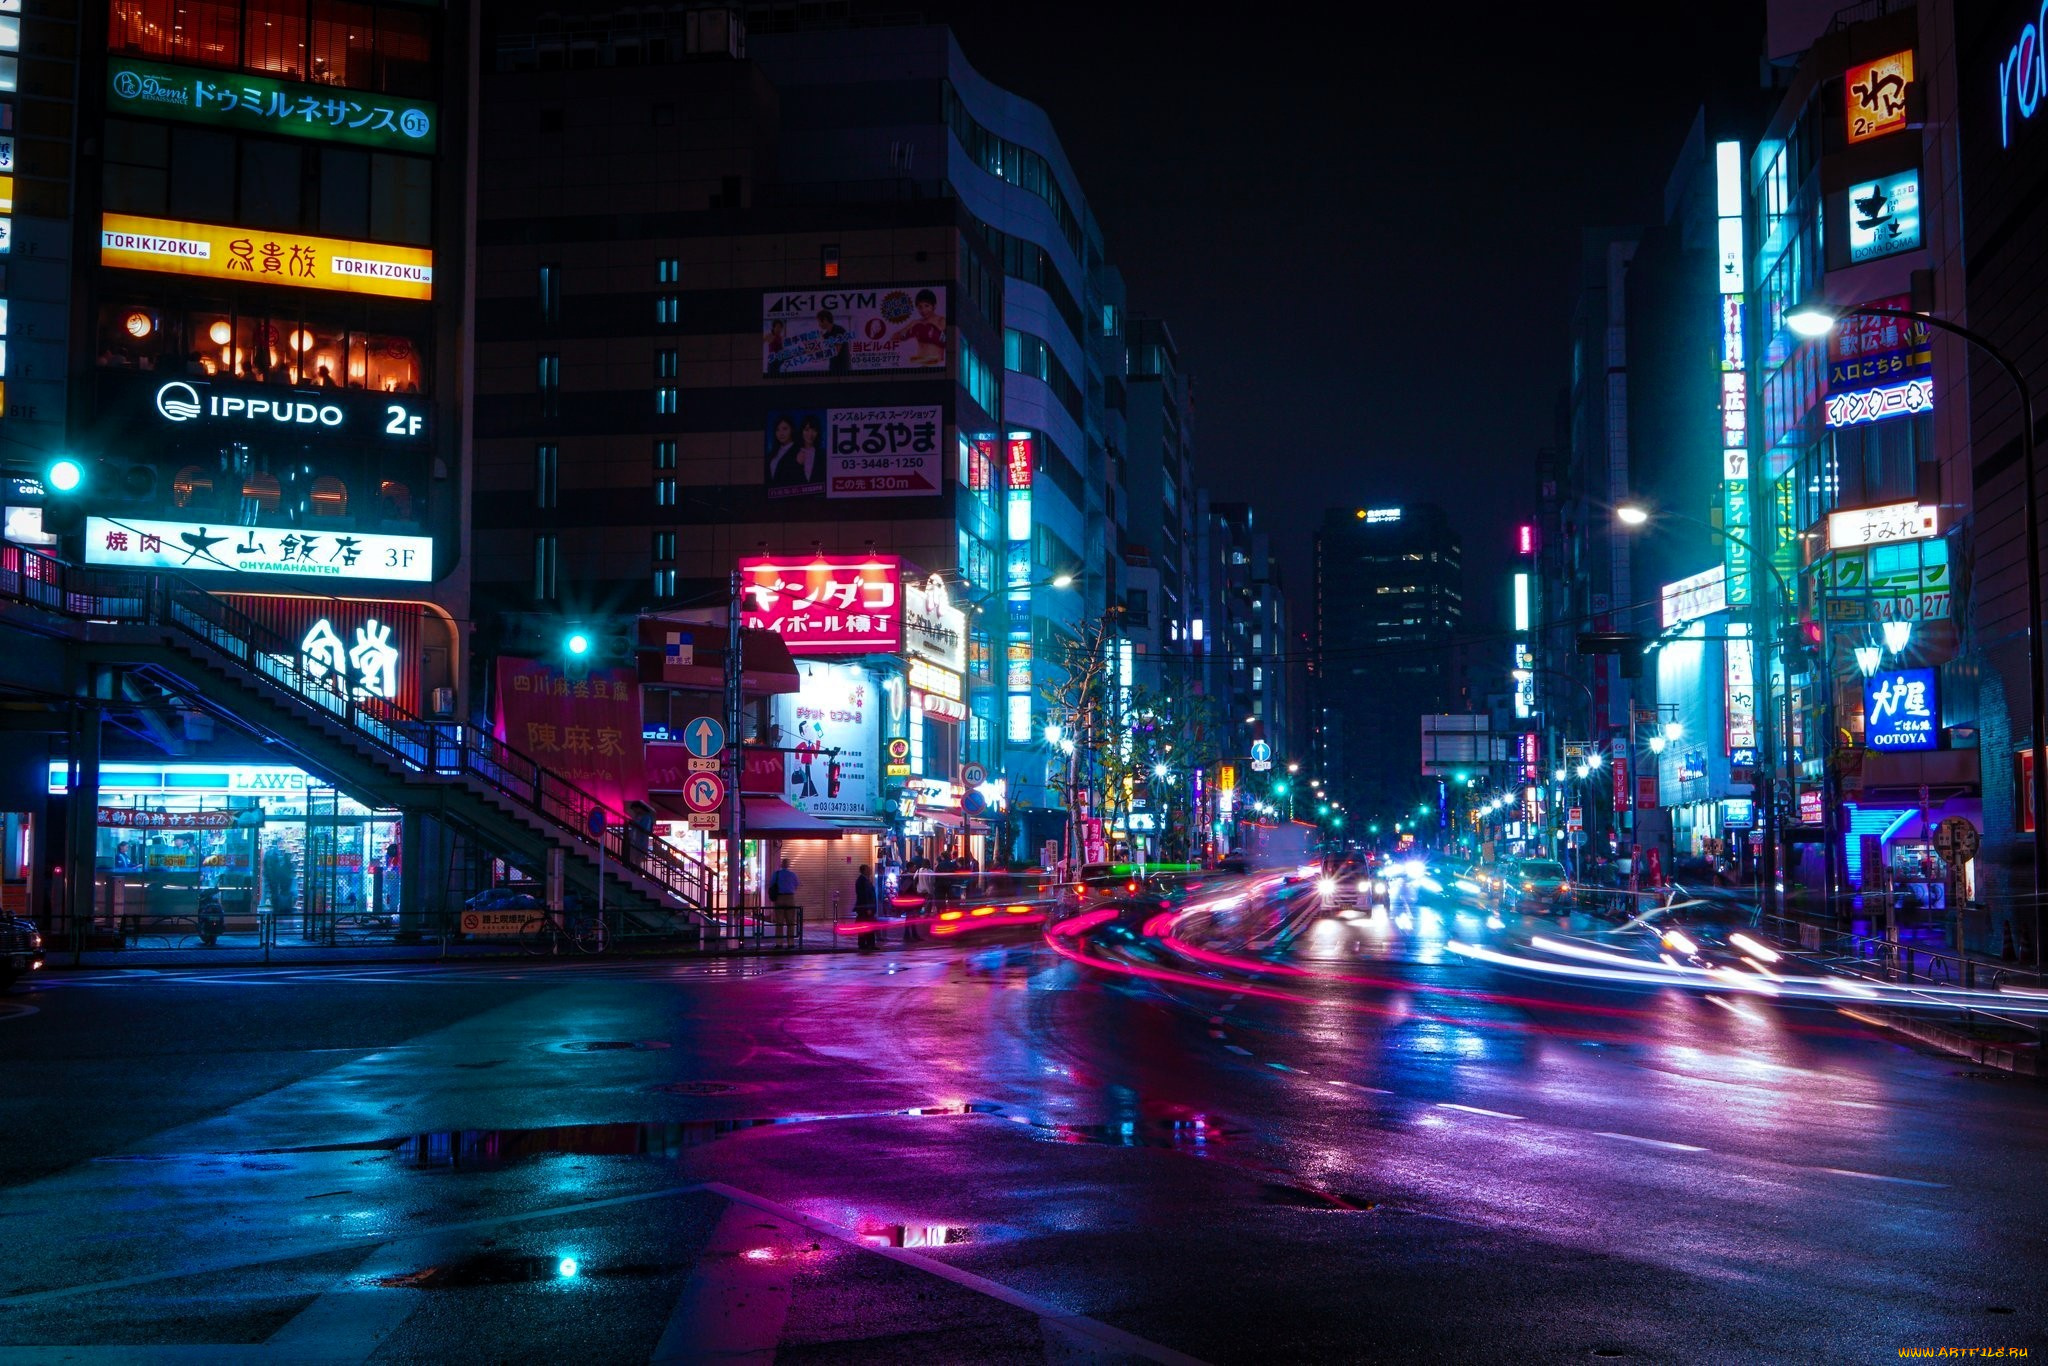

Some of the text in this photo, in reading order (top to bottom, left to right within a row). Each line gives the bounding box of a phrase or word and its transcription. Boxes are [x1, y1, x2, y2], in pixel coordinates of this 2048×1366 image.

[194, 80, 399, 135] ドゥミルネサンス
[405, 114, 428, 134] 6F
[1853, 117, 1874, 137] 2F
[18, 241, 39, 255] 3F
[105, 232, 199, 258] TORIKIZOKU
[227, 238, 317, 278] 鳥貴族
[335, 258, 423, 281] TORIKIZOKU
[821, 292, 877, 310] GYM
[1838, 327, 1899, 357] 歌広場
[1830, 355, 1903, 383] 入口こちら
[10, 405, 37, 419] B1F
[210, 395, 344, 426] IPPUDO
[385, 405, 423, 436] 2F
[832, 421, 936, 455] はるやま
[841, 458, 924, 470] 03-3448-1250
[834, 476, 909, 491] この先 130m
[105, 530, 162, 554] 焼肉
[1728, 481, 1747, 603] シティクリニック
[1859, 518, 1919, 542] すみれ
[180, 526, 364, 567] 大山飯店
[384, 547, 415, 568] 3F
[238, 560, 340, 575] OHYAMAHANTEN
[748, 612, 891, 634] ハイボール横丁
[513, 674, 629, 703] 四川麻婆豆腐
[1870, 675, 1931, 726] 大戸屋
[527, 721, 626, 758] 陳麻家
[1874, 732, 1927, 745] OOTOYA
[966, 769, 982, 781] 40
